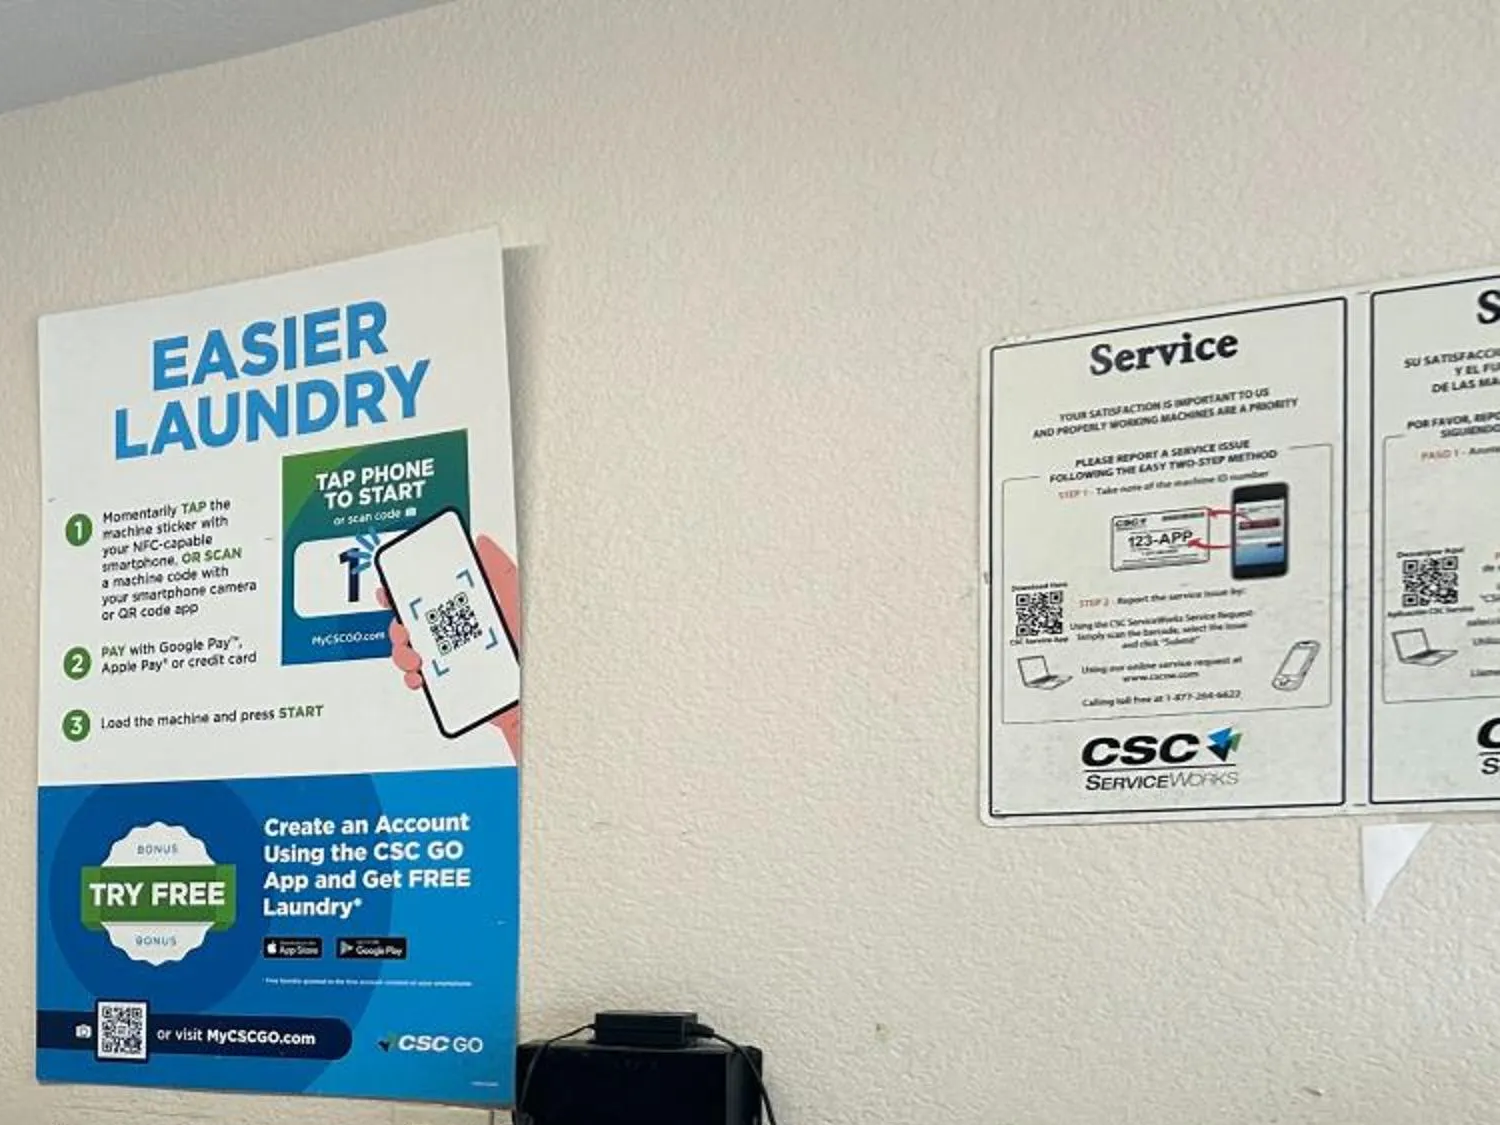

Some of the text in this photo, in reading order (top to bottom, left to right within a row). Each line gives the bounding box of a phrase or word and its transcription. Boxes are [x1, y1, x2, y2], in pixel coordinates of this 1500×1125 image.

[153, 301, 388, 391] EASIER
[1089, 332, 1240, 377] Service
[1404, 357, 1421, 368] SU
[1431, 379, 1476, 393] DE LAS
[115, 359, 431, 460] LAUNDRY
[1059, 411, 1087, 422] YOUR
[1089, 402, 1161, 419] SATISFACTION
[1174, 392, 1237, 408] IMPORTANT
[1240, 389, 1253, 400] TO
[1255, 387, 1269, 397] US
[1033, 397, 1299, 439] AND PROPERLY WORKING MACHINES ARE A PRIORITY
[1075, 439, 1250, 468] PLEASE REPORT A SERVICE ISSUE
[315, 458, 435, 492] TAP PHONE
[1049, 449, 1278, 483] FOLLOWING THE EASY TWO-STEP METHOD
[324, 480, 427, 510] TO START
[103, 499, 231, 524] Momentarily TAP the
[333, 508, 402, 526] or scan code
[103, 516, 229, 540] machine sticker with
[1128, 530, 1193, 548] 123-APP
[102, 535, 213, 558] your NFC-capable
[102, 548, 243, 575] smartphone, OR SCAN
[102, 566, 229, 589] a machine code with
[102, 581, 257, 607] your smartphone camera
[102, 602, 199, 622] or QR code app
[101, 646, 125, 658] PAY
[129, 643, 156, 656] with
[159, 640, 204, 656] Google
[101, 660, 137, 675] Apple
[171, 659, 184, 669] or
[187, 655, 225, 668] credit
[228, 652, 257, 665] card
[101, 705, 324, 729] Load the machine and press START
[1081, 733, 1201, 767] CSC
[264, 812, 471, 838] Create an Account
[136, 843, 180, 857] BONUS
[263, 841, 465, 867] Using the CSC GO
[263, 869, 471, 894] App and Get FREE
[89, 880, 226, 908] TRY FREE
[135, 935, 178, 949] BONUS
[279, 945, 319, 957] App Store
[356, 945, 404, 958] Google Play
[157, 1028, 317, 1048] or visit MyCSCGO.com
[398, 1035, 485, 1054] CSC GO
